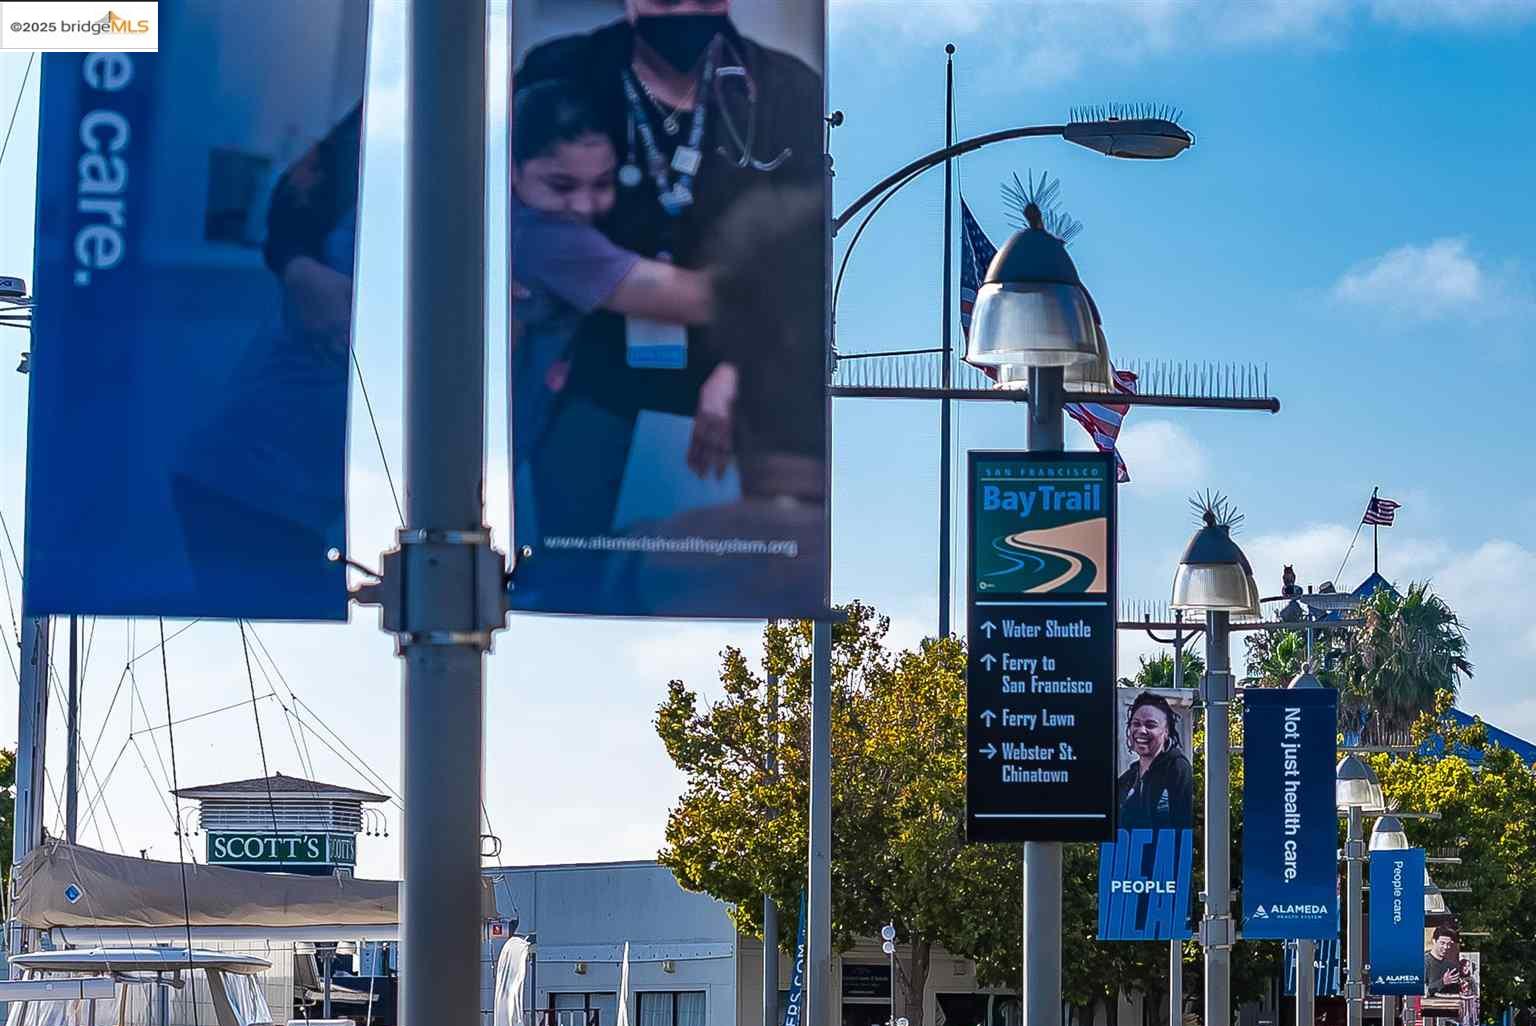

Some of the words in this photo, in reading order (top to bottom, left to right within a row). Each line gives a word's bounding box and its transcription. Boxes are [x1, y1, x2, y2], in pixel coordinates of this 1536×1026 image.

[73, 108, 131, 288] care.
[985, 467, 1012, 477] SAN
[1020, 467, 1099, 477] FRANCISCO
[1002, 619, 1041, 638] Water
[1045, 619, 1092, 638] Shuttle
[1002, 652, 1038, 675] Ferry
[1041, 655, 1056, 671] to
[1002, 675, 1026, 694] San
[1031, 675, 1093, 694] Francisco
[1002, 708, 1038, 731] Ferry
[1042, 708, 1076, 727] Lawn
[1284, 707, 1301, 739] Not
[1001, 741, 1055, 760] Webster
[1059, 741, 1077, 760] St.
[1280, 742, 1301, 777] just
[1001, 764, 1069, 783] Chinatown
[1284, 781, 1302, 836] health
[214, 836, 320, 859] SCOTT'S
[1284, 840, 1298, 884] care.
[1111, 880, 1176, 894] PEOPLE
[1392, 860, 1404, 897] People
[1271, 904, 1329, 915] ALAMEDA
[1393, 899, 1402, 926] care.
